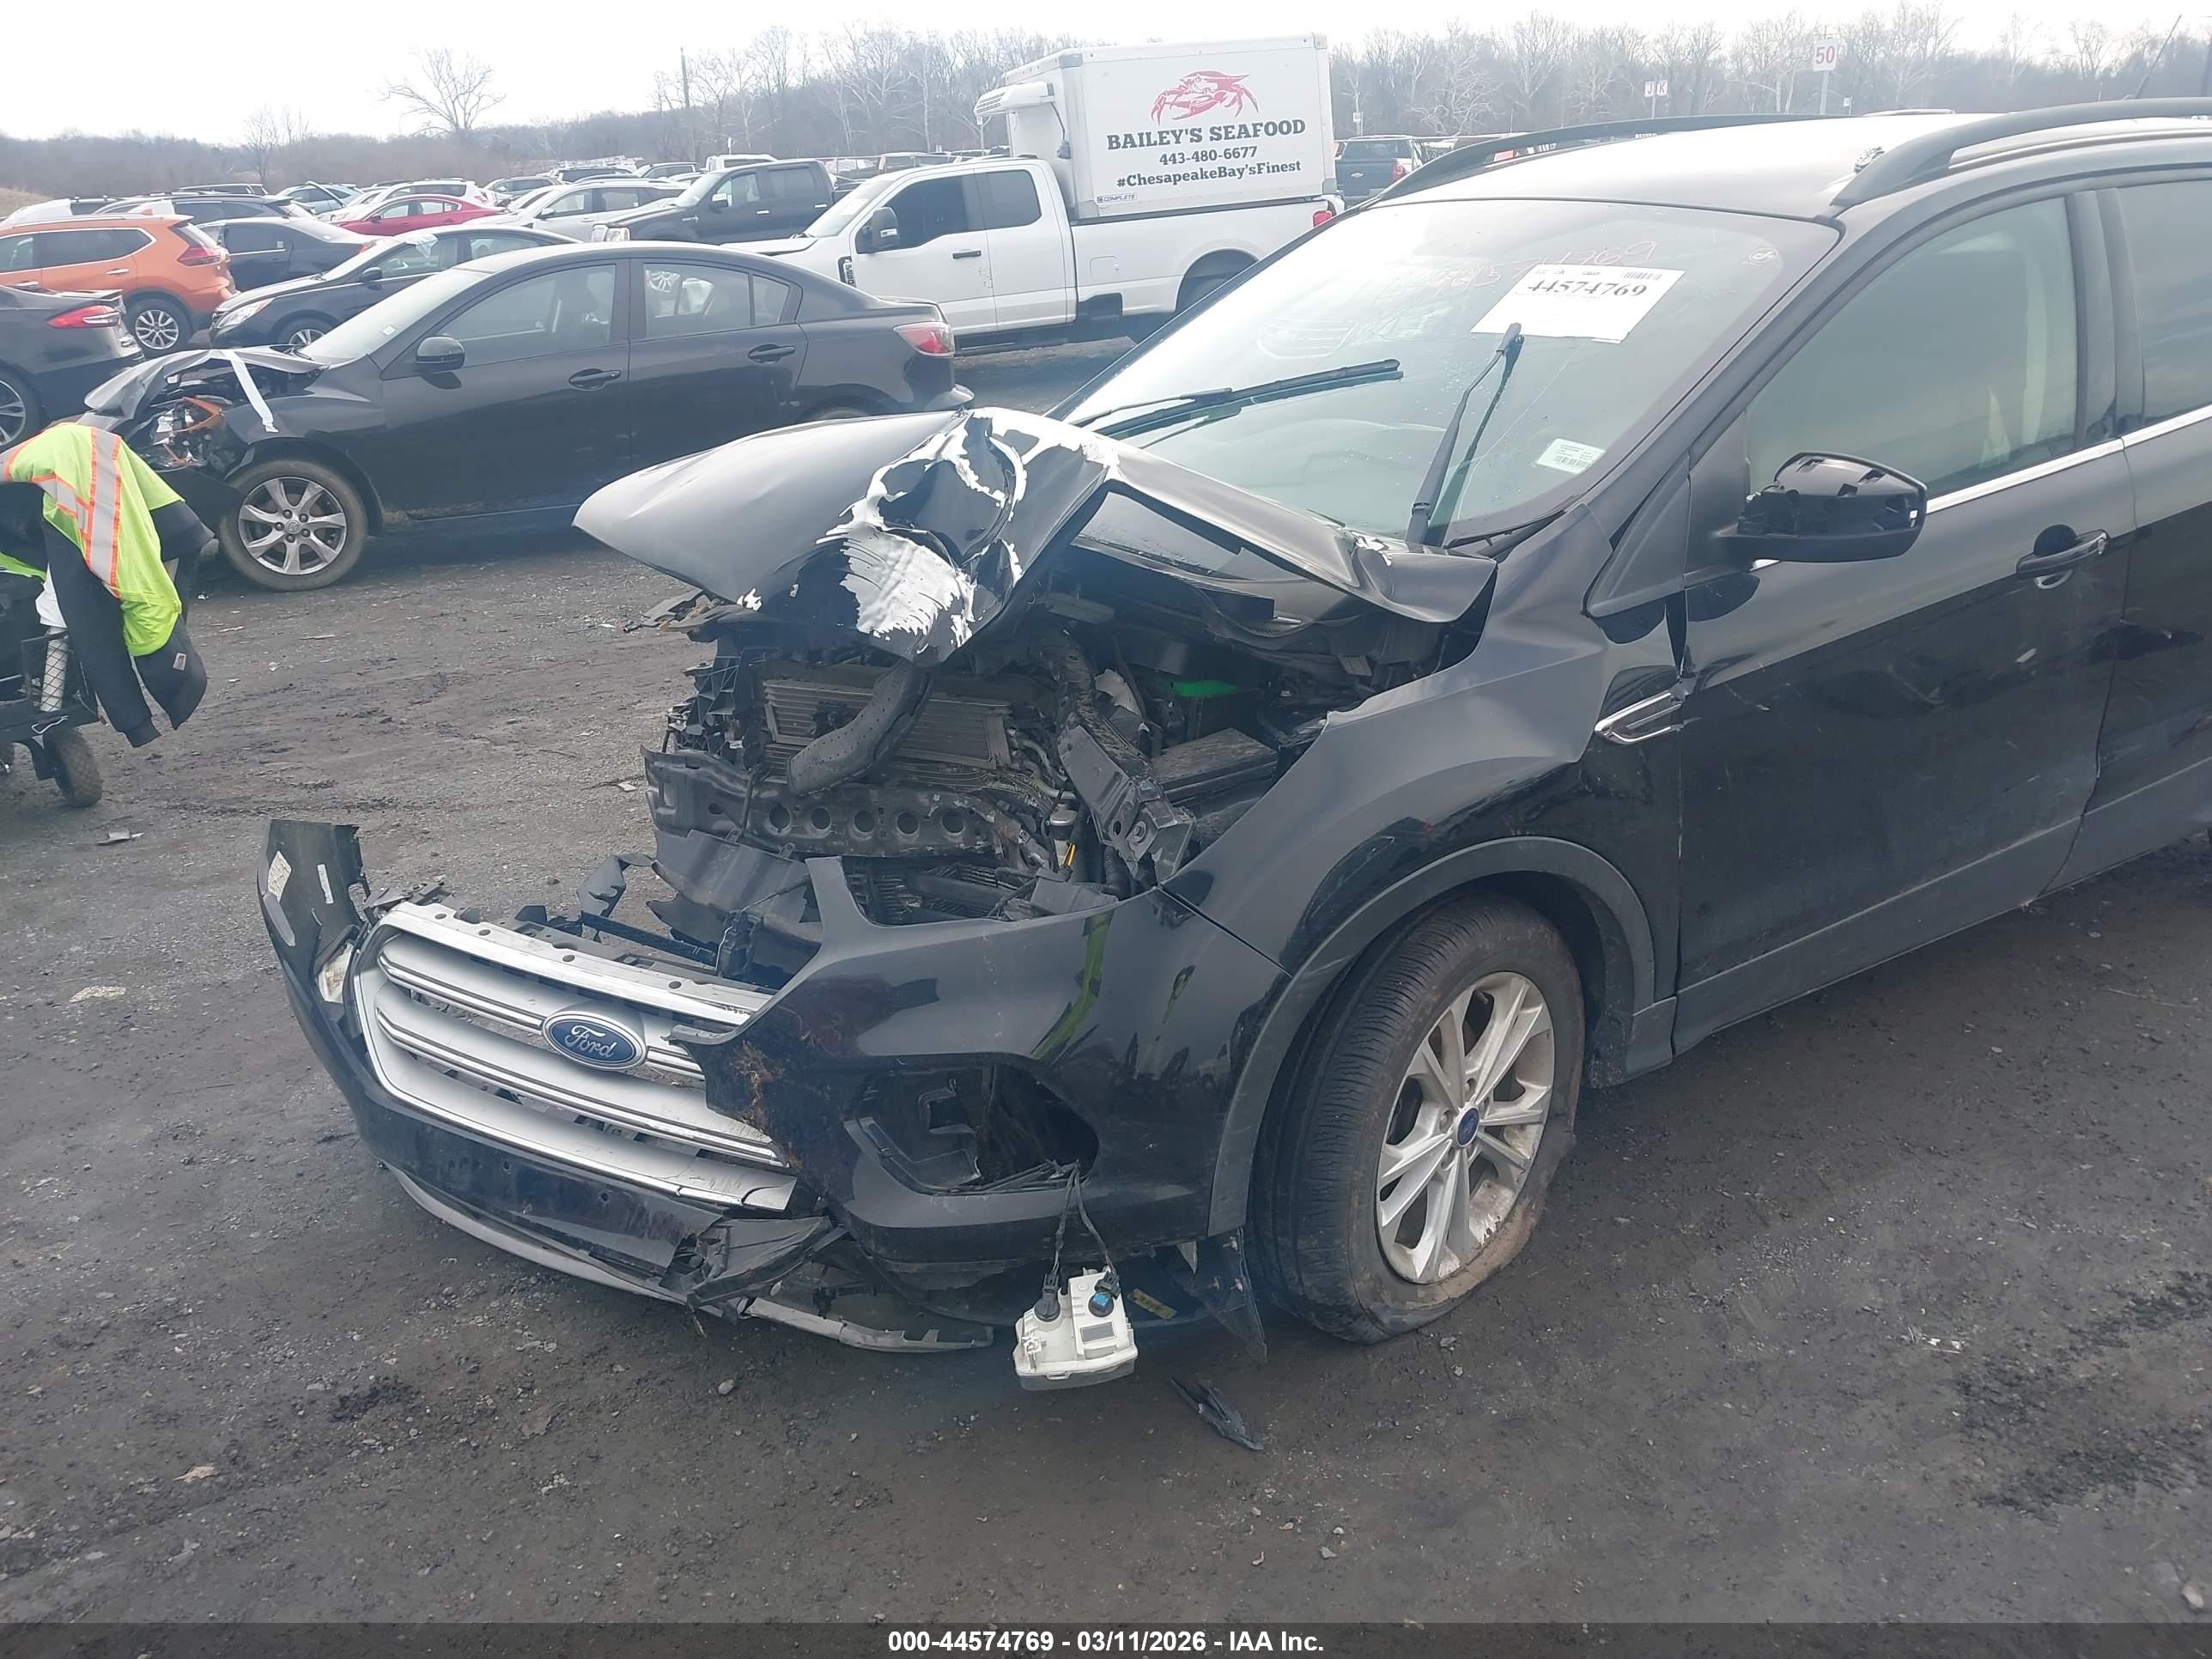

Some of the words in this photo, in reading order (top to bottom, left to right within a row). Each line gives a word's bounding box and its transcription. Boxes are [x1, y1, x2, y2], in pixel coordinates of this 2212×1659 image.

[1815, 45, 1835, 64] 50
[1106, 127, 1203, 150] BAILEY'S
[1209, 119, 1306, 142] SEAFOOD
[1159, 145, 1258, 166] 443-480-6677
[1116, 161, 1302, 186] #ChesapeakeBay'sFinest
[1528, 280, 1648, 297] 44574769
[564, 1024, 618, 1058] Ford
